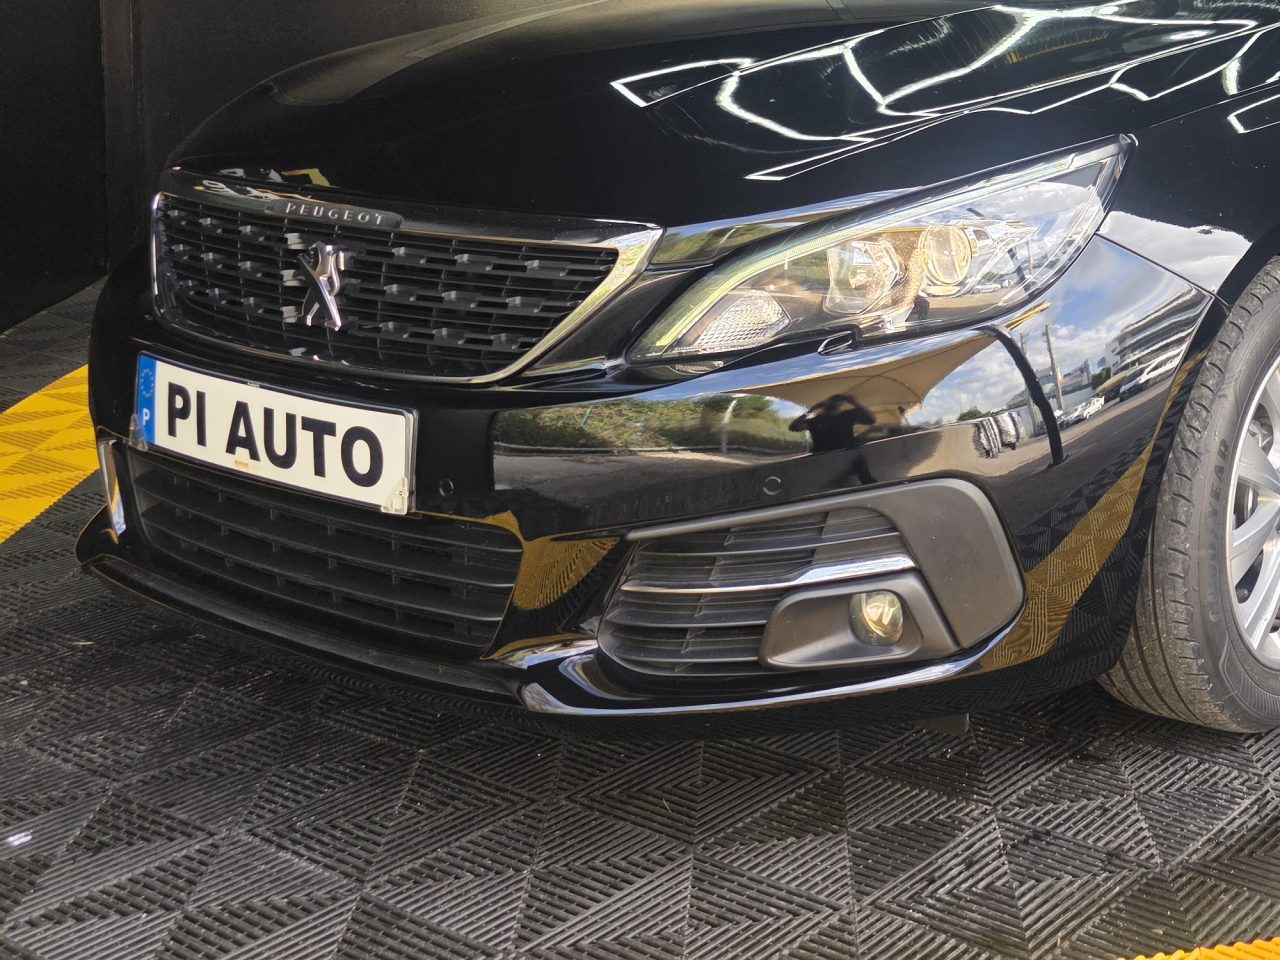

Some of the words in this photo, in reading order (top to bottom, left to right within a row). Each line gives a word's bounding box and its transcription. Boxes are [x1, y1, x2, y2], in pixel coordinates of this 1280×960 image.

[285, 202, 385, 225] PEUGEOT
[142, 407, 151, 426] P
[168, 381, 207, 448] PI
[225, 400, 384, 488] AUTO
